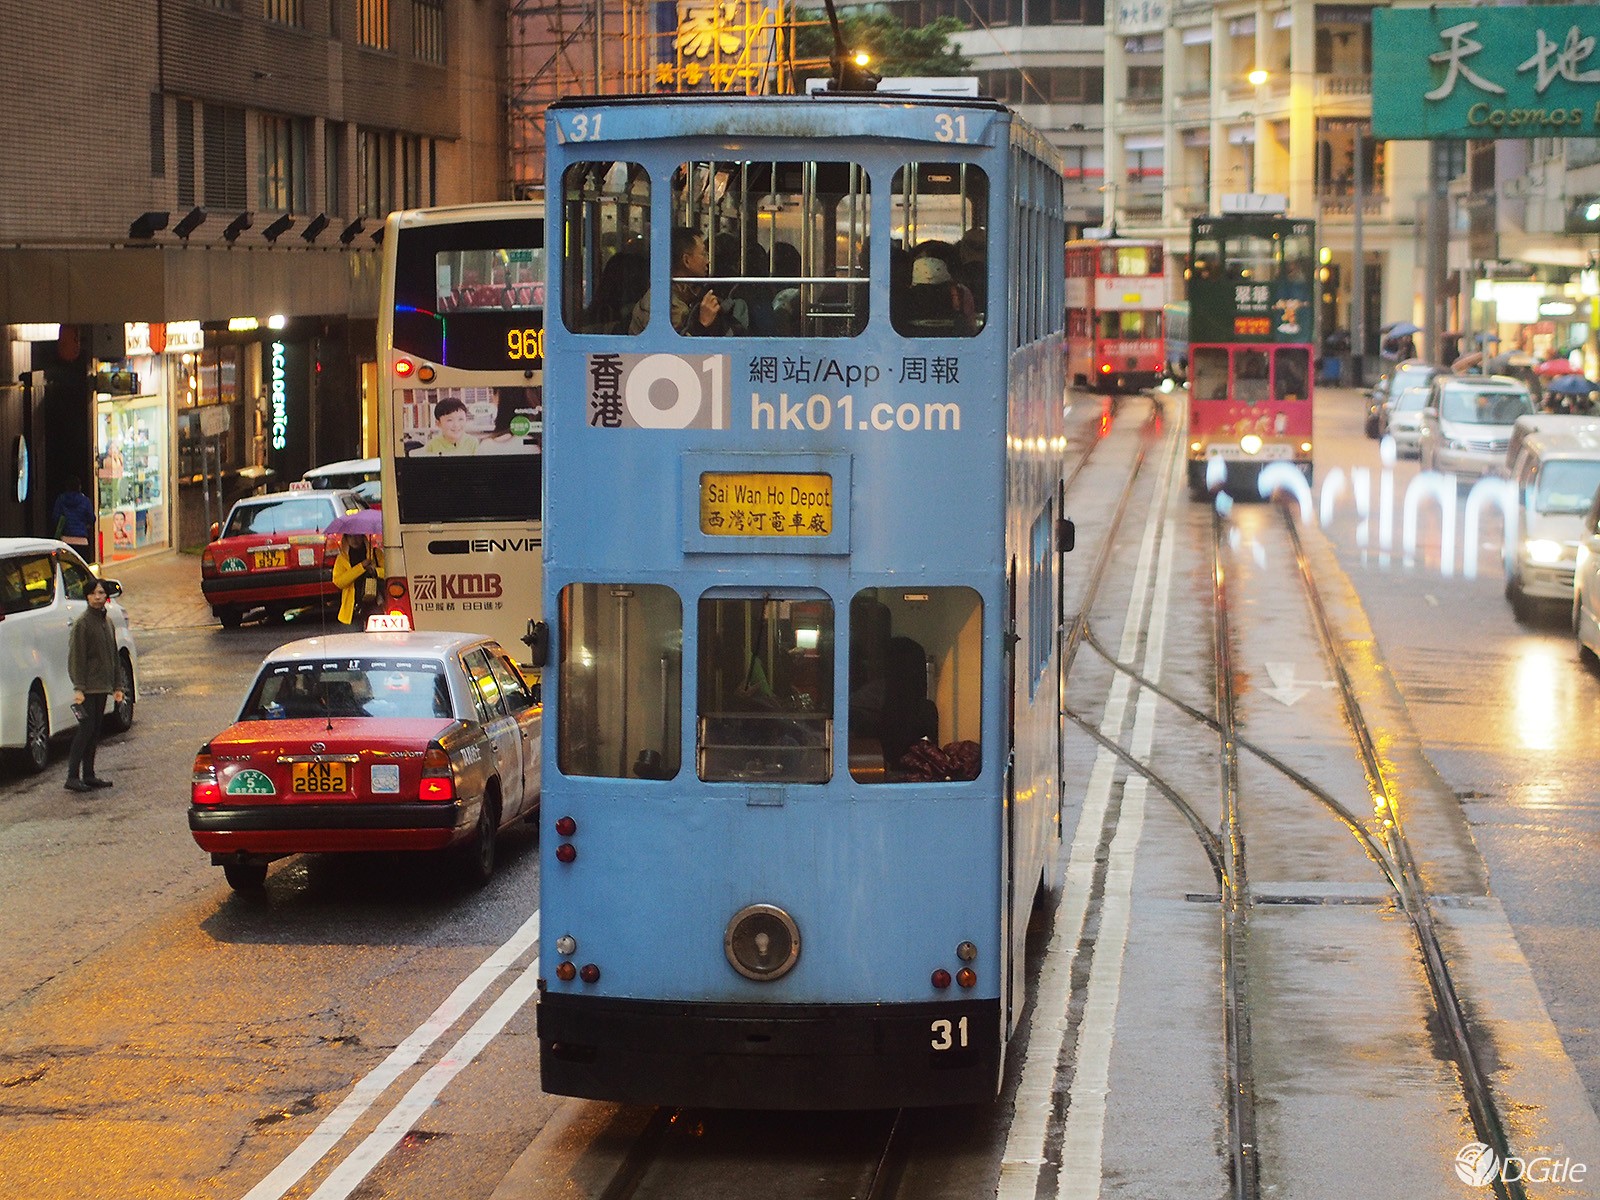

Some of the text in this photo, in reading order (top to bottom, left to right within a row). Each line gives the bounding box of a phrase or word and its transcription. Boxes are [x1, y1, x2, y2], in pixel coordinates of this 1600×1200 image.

[1424, 21, 1600, 101] 天地
[1467, 103, 1583, 126] Cosmos
[569, 112, 603, 142] 31
[934, 113, 969, 143] 31
[590, 353, 624, 428] 香港
[751, 393, 961, 431] hk01.com
[291, 483, 310, 491] TAXI
[708, 484, 830, 510] Sai Wan Ho Depot
[708, 509, 829, 533] 西灣河電車廠
[259, 557, 281, 567] 937
[441, 573, 503, 599] KMB
[371, 618, 404, 628] TAXI
[237, 772, 263, 781] TAXI
[246, 777, 256, 787] 5
[307, 763, 331, 778] KN
[294, 777, 343, 792] 2862
[931, 1016, 968, 1050] 31
